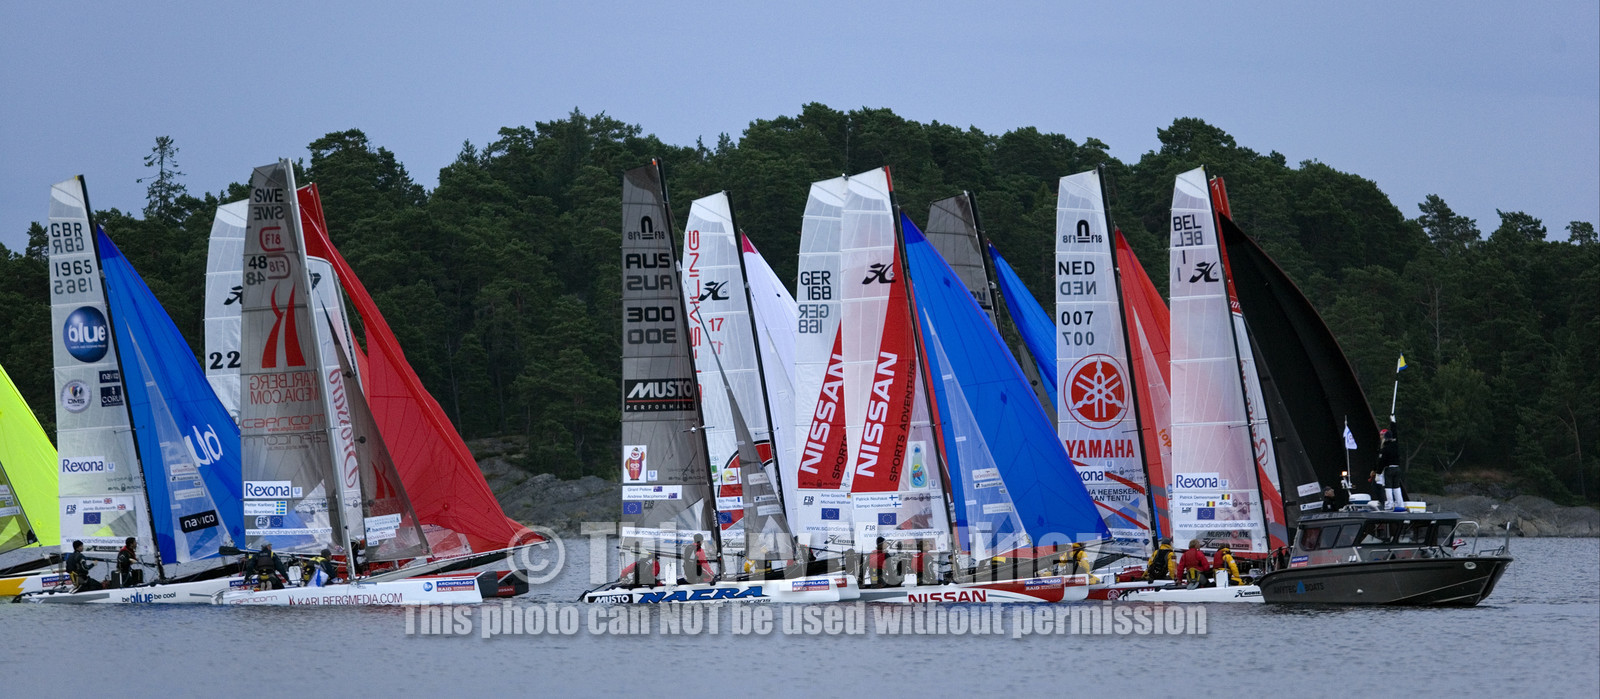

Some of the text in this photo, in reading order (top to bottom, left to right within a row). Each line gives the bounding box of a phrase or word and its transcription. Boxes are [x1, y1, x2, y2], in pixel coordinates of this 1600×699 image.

[254, 188, 284, 203] SWE
[51, 222, 83, 237] GBR
[1173, 214, 1202, 231] BEL
[265, 233, 281, 245] F18
[55, 259, 93, 277] 1965
[248, 255, 268, 270] 48
[625, 253, 671, 269] AUS
[1058, 261, 1095, 276] NED
[800, 271, 831, 286] GER
[807, 286, 832, 300] 168
[627, 306, 675, 322] 300
[1061, 311, 1094, 325] 007
[68, 322, 106, 343] blue
[708, 318, 724, 332] 17
[627, 380, 694, 399] MUSTO
[800, 353, 844, 475] NISSAN
[856, 351, 898, 478] NISSAN
[1065, 439, 1135, 458] YAMAHA
[62, 458, 104, 473] Rexona
[889, 434, 906, 483] SPORTS
[1078, 469, 1104, 481] xona
[1176, 474, 1218, 488] Rexona
[245, 482, 290, 497] Rexona
[1107, 494, 1131, 502] TENTIJ
[184, 514, 215, 529] navico
[1304, 582, 1325, 592] BOATS
[298, 592, 402, 605] KARLBERGMEDIA.COM
[594, 594, 630, 604] MUSTO
[908, 589, 986, 603] NISSAN
